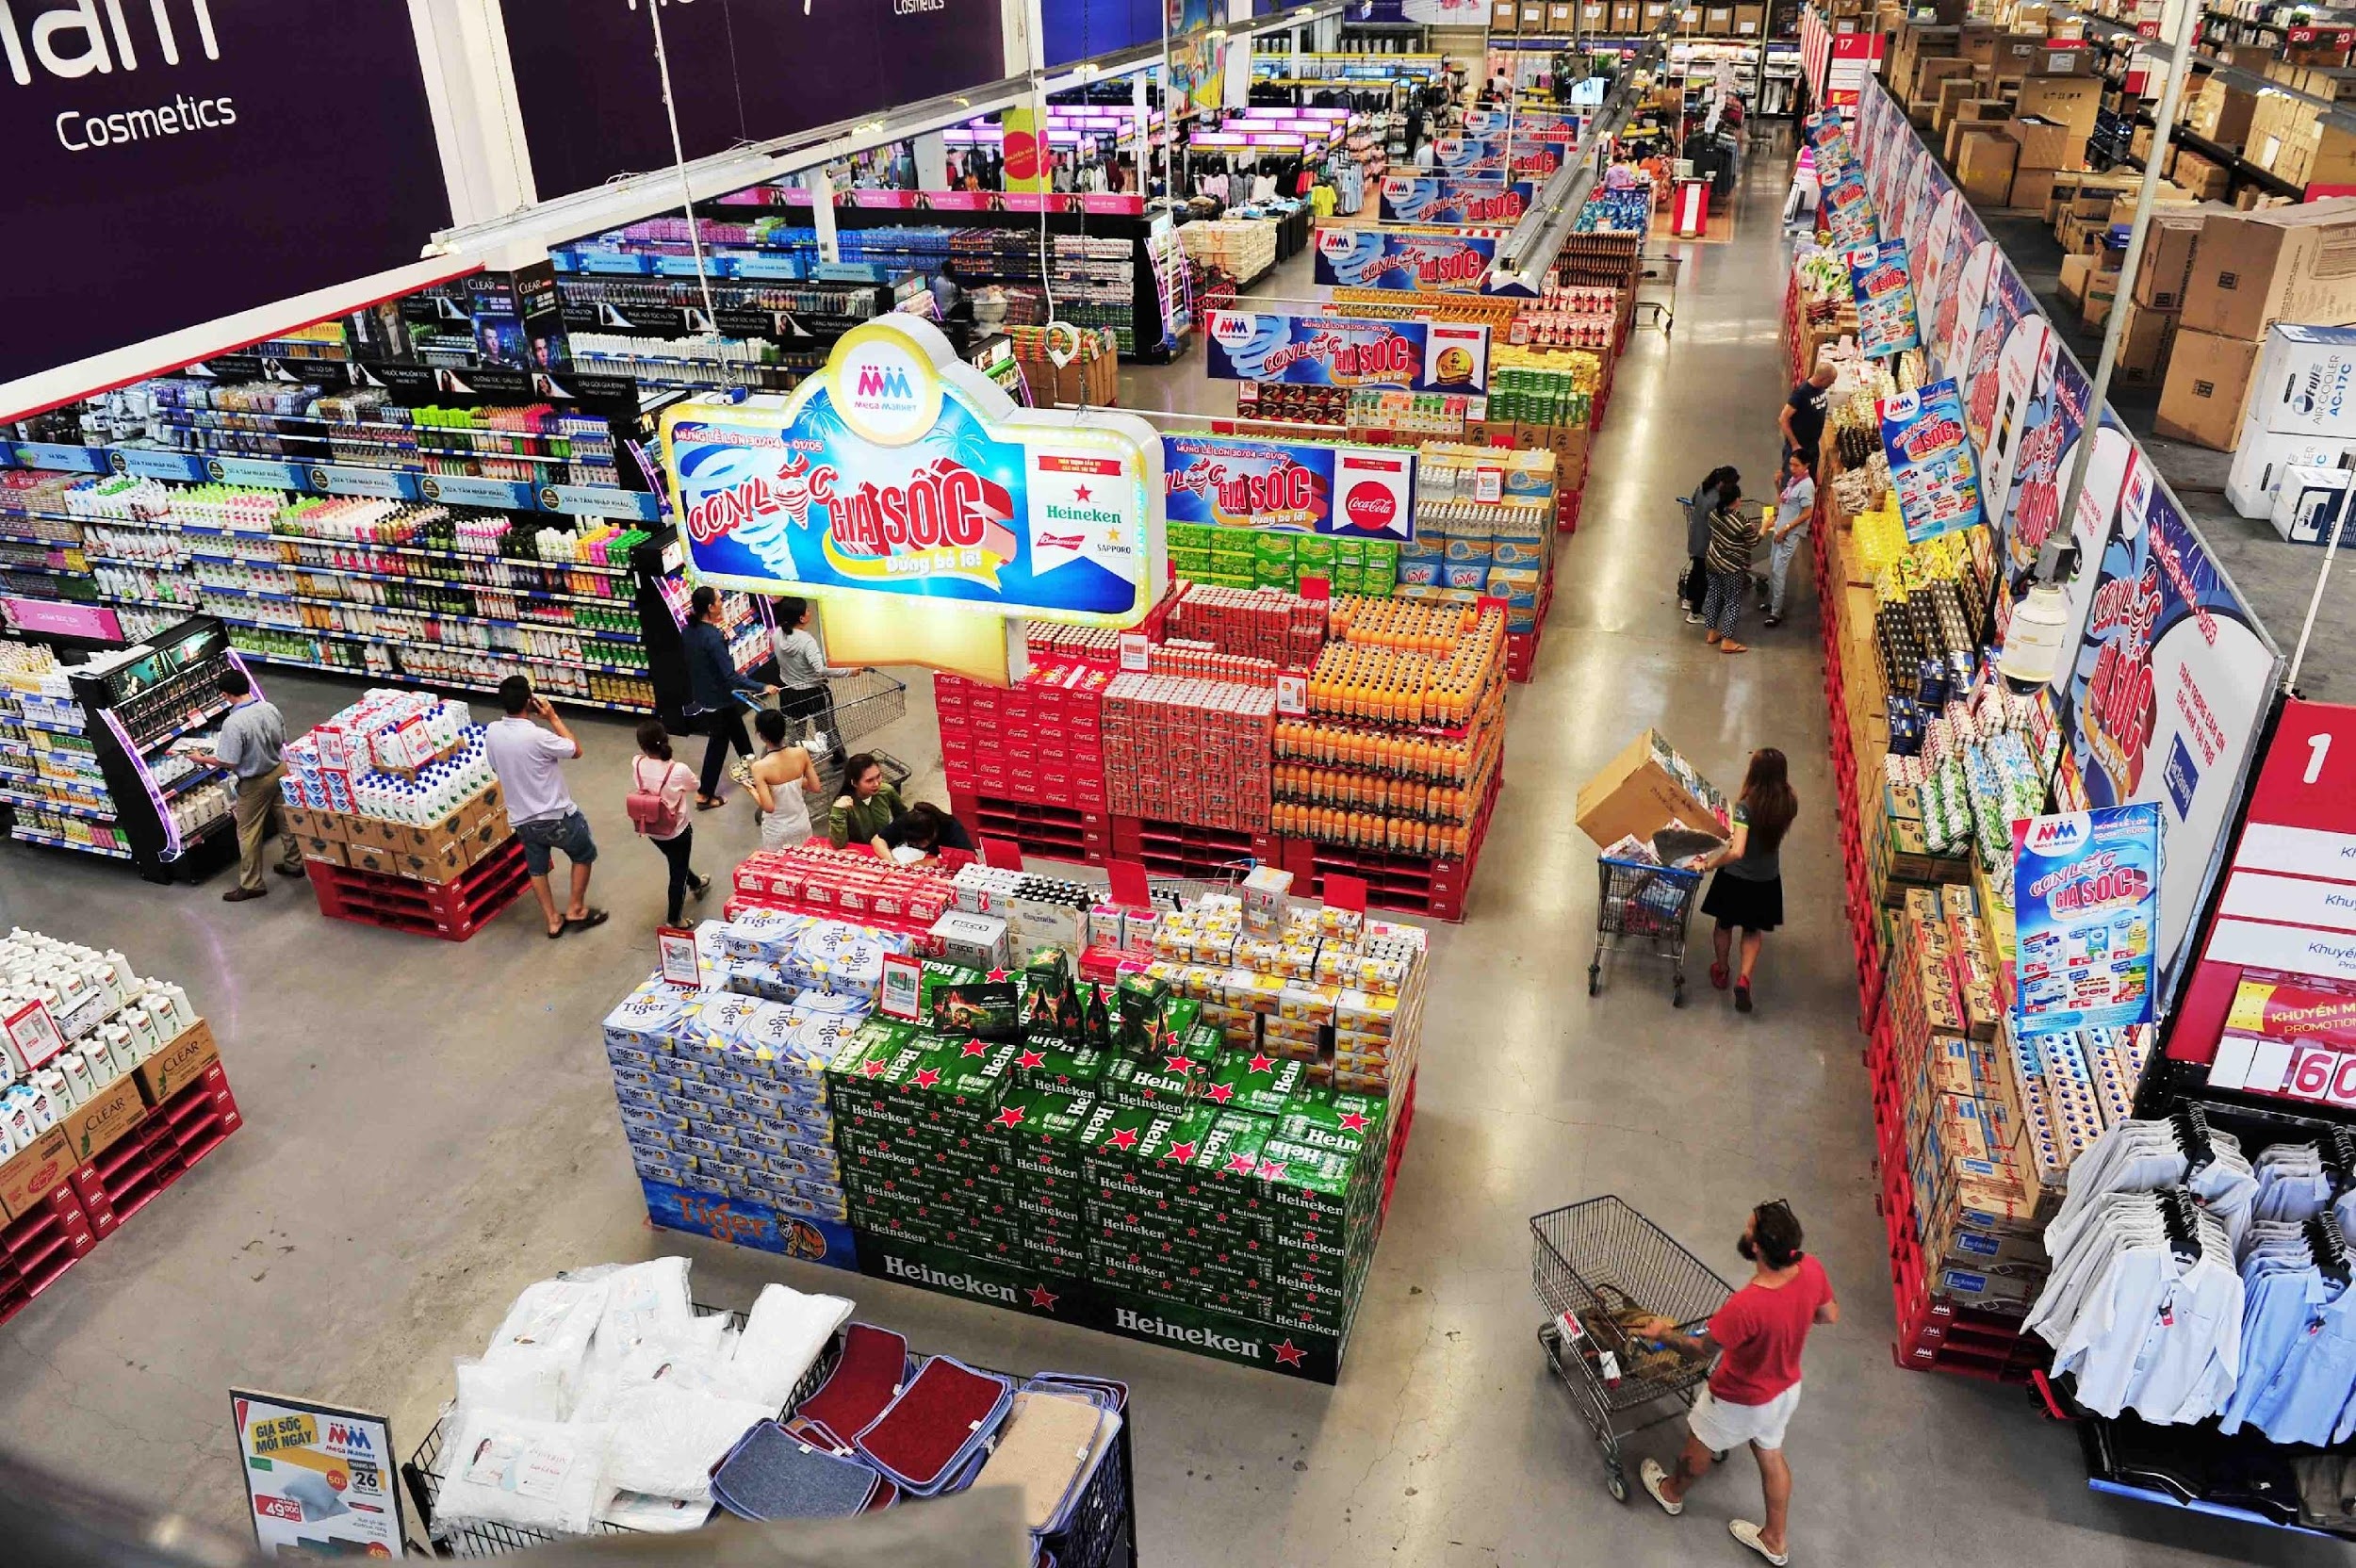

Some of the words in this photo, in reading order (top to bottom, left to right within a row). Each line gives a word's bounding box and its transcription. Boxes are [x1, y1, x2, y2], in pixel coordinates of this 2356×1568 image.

[2141, 25, 2154, 36] 19
[2292, 31, 2311, 41] 20
[1839, 39, 1854, 50] 17
[57, 94, 237, 151] Cosmetics
[1439, 245, 1481, 280] SỐC
[467, 279, 496, 290] CLEAR
[518, 280, 541, 295] CLEAR
[1359, 332, 1409, 372] SỐC
[2318, 354, 2341, 405] COOLER
[2330, 364, 2352, 416] AC-17C
[2313, 406, 2324, 425] AIR
[792, 439, 824, 452] 01/05
[1232, 449, 1256, 459] 30/04
[1264, 451, 1288, 461] 01/05
[1218, 473, 1247, 510] GIÁ
[1249, 459, 1312, 511] SỐC
[688, 481, 754, 546] CƠN
[828, 482, 879, 546] GIÁ
[879, 457, 988, 548] SỐC
[1046, 505, 1121, 524] Heineken
[1040, 534, 1084, 547] Budweiser
[1097, 544, 1131, 555] SAPPORO
[2196, 610, 2219, 647] 01/05
[2302, 732, 2332, 784] 1
[2082, 866, 2135, 904] SỐC
[742, 915, 785, 928] Tiger
[728, 939, 748, 951] Tiger
[823, 925, 847, 953] Tiger
[2308, 942, 2356, 958] Khuyế
[845, 945, 870, 974] Tiger
[623, 1000, 667, 1016] Tiger
[721, 997, 746, 1026] Tiger
[769, 1007, 794, 1038] Tiger
[818, 1018, 844, 1048] Tiger
[605, 1028, 629, 1040] Tiger
[163, 1041, 201, 1073] CLEAR
[615, 1068, 638, 1081] Tiger
[756, 1079, 777, 1091] Tiger
[835, 1085, 871, 1098] Heineken
[1035, 1079, 1096, 1100] Heineken
[86, 1096, 126, 1132] CLEAR
[852, 1103, 911, 1125] Heineken
[1120, 1093, 1182, 1115] Heineken
[858, 1144, 916, 1166] Heineken
[1017, 1159, 1078, 1179] Heineken
[1100, 1177, 1164, 1199] Heineken
[1201, 1180, 1241, 1195] Heineken
[1019, 1199, 1078, 1222] Heineken
[1276, 1192, 1344, 1217] Heineken
[673, 1194, 770, 1244] Tiger
[870, 1222, 926, 1244] Heineken
[1105, 1256, 1166, 1279] Heineken
[883, 1255, 1018, 1303] Heineken
[1115, 1308, 1261, 1359] Heineken
[1276, 1315, 1340, 1338] Heineken
[255, 1421, 275, 1438] GIÁ
[278, 1416, 302, 1432] SỐC
[255, 1435, 279, 1453] MỖI
[282, 1430, 312, 1448] NGÀY
[354, 1471, 377, 1488] 26
